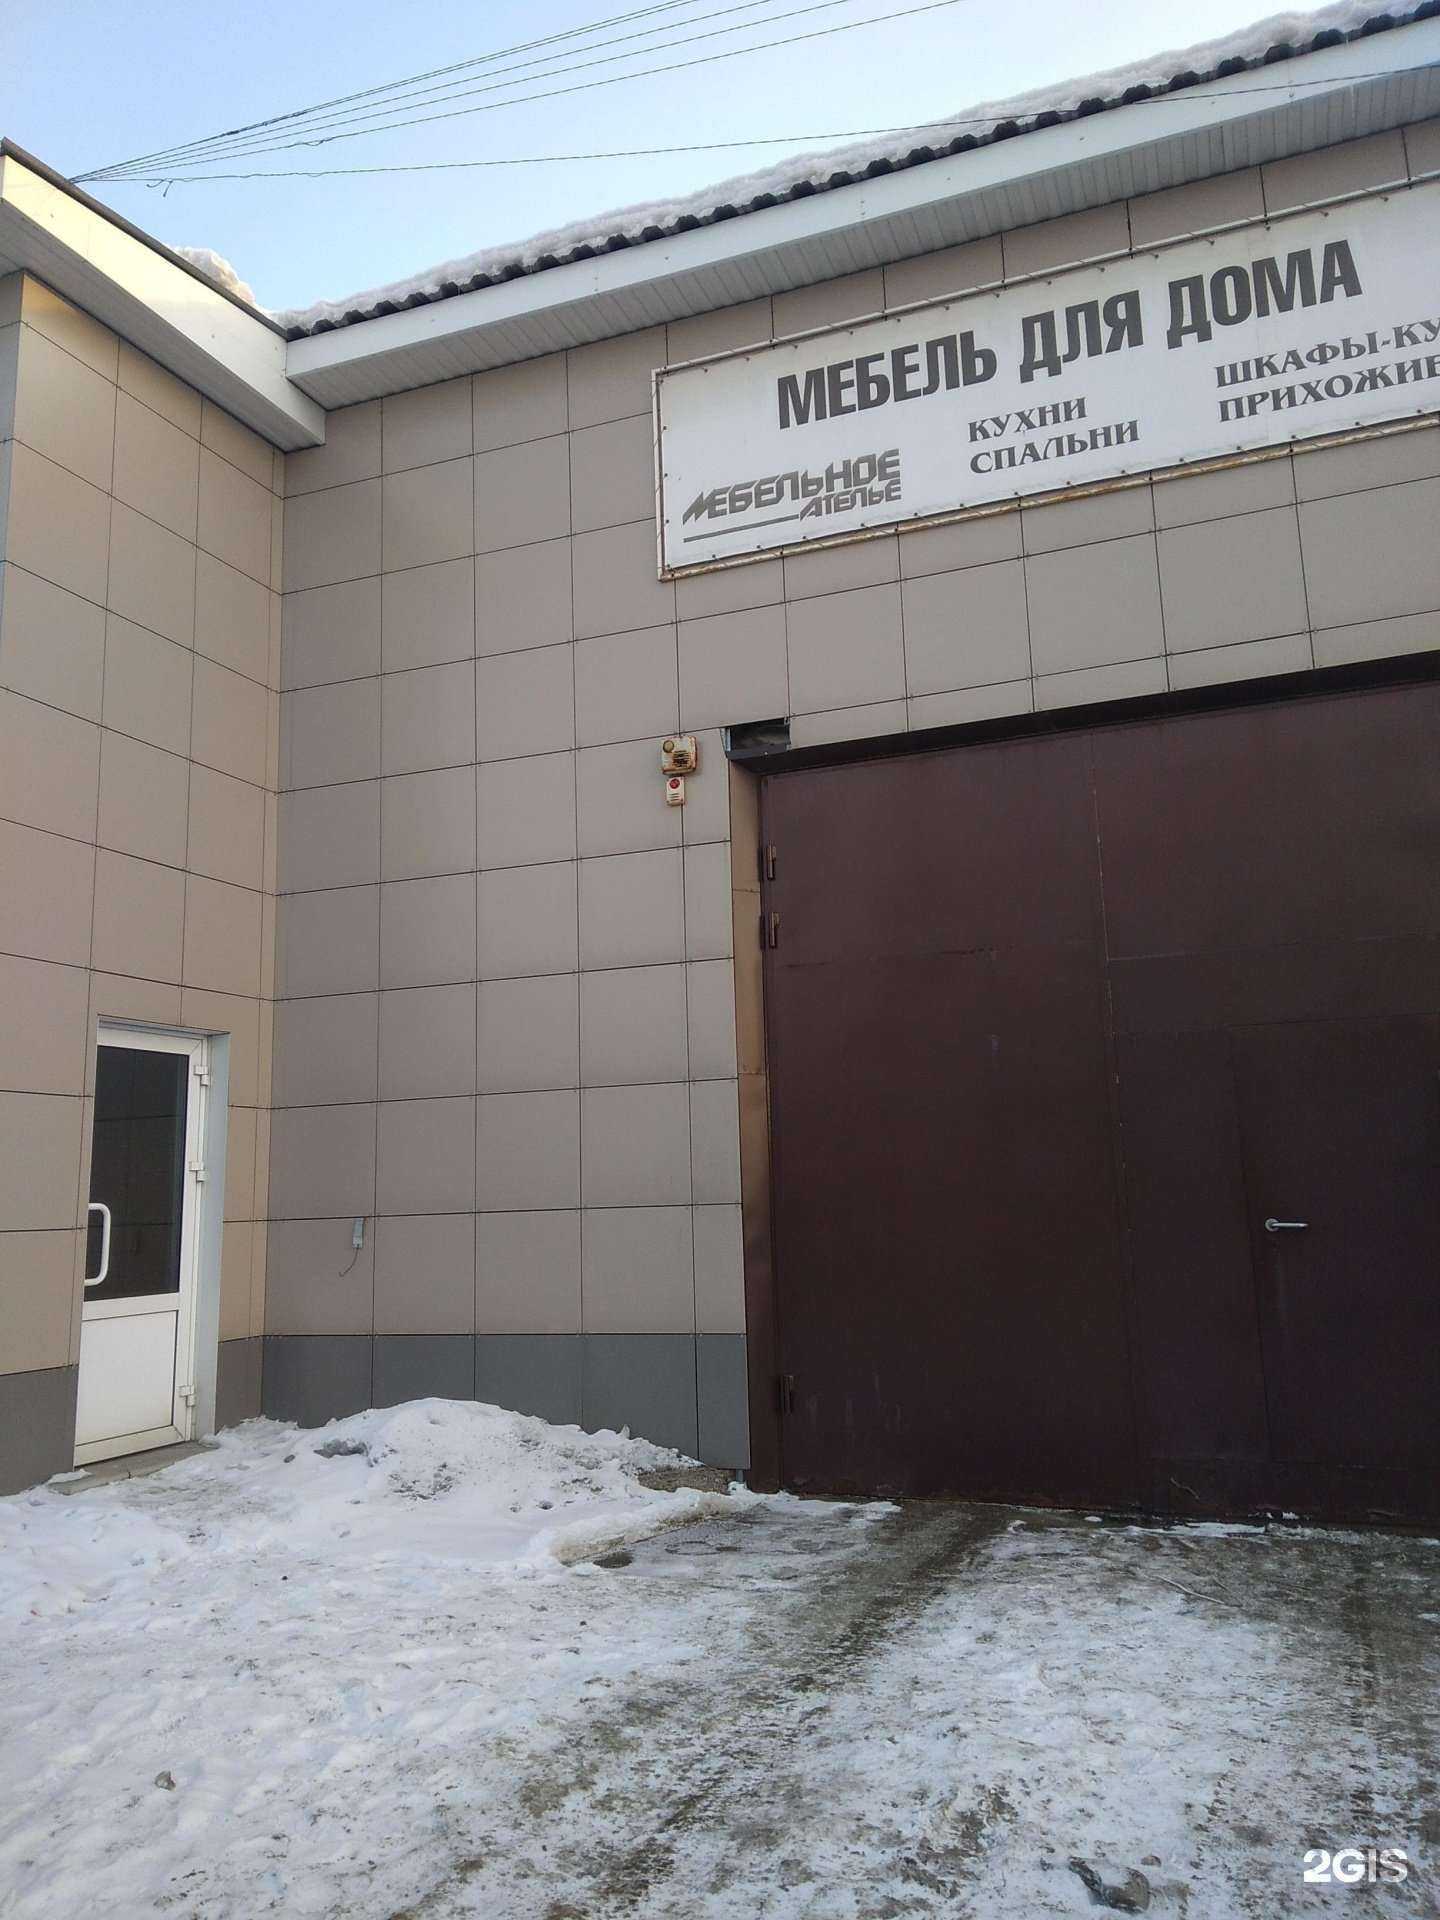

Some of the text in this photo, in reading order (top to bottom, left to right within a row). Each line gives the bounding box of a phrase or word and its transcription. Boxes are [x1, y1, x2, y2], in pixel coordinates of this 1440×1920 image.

[777, 239, 1363, 429] МЕБЕЛЬ ДЛЯ ДОМА
[1214, 317, 1440, 388] ШКАФЫ-КУ
[968, 397, 1088, 442] КУХНИ
[970, 419, 1140, 474] СПАЛЬНИ
[682, 448, 900, 526] МЕБЕЛЬНОЕ
[799, 479, 902, 521] АТЕЛЬЕ
